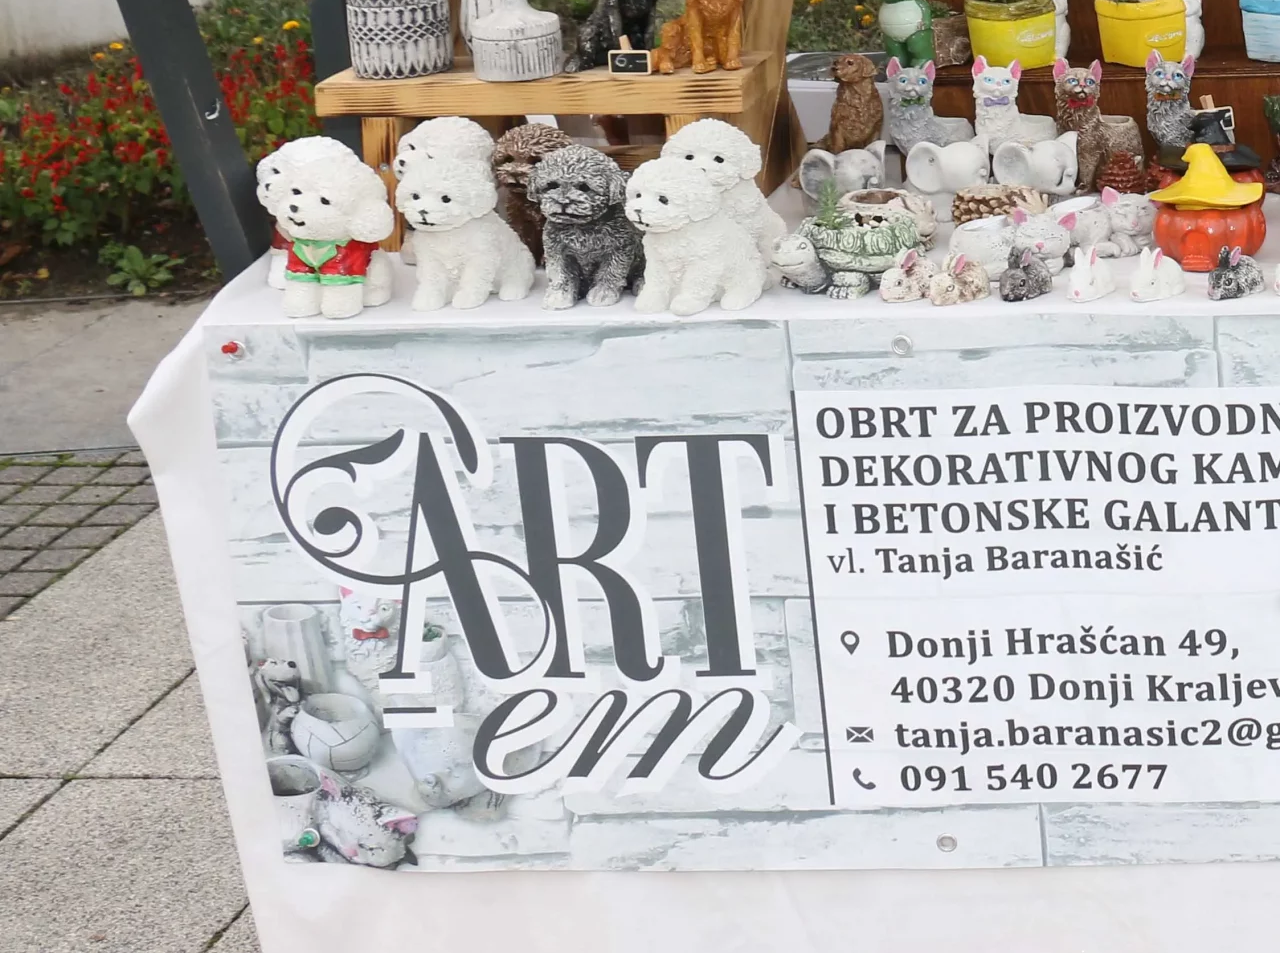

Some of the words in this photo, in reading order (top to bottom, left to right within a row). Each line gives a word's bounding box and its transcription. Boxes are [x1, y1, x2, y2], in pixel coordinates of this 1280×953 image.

[815, 405, 938, 440] OBRT
[951, 403, 1012, 438] ZA
[820, 450, 1179, 488] DEKORATIVNOG
[270, 373, 773, 682] ART
[825, 504, 839, 536] I
[853, 498, 1091, 535] BETONSKE
[827, 548, 866, 575] vl.
[874, 547, 974, 580] Tanja
[985, 542, 1164, 573] Baranašić
[886, 629, 993, 665] Donji
[1006, 625, 1168, 657] Hrašćan
[1178, 627, 1241, 661] 49,
[890, 675, 1016, 704] 40320
[1028, 673, 1135, 709] Donji
[899, 764, 973, 793] 091
[986, 763, 1059, 791] 540
[1071, 762, 1169, 791] 2677
